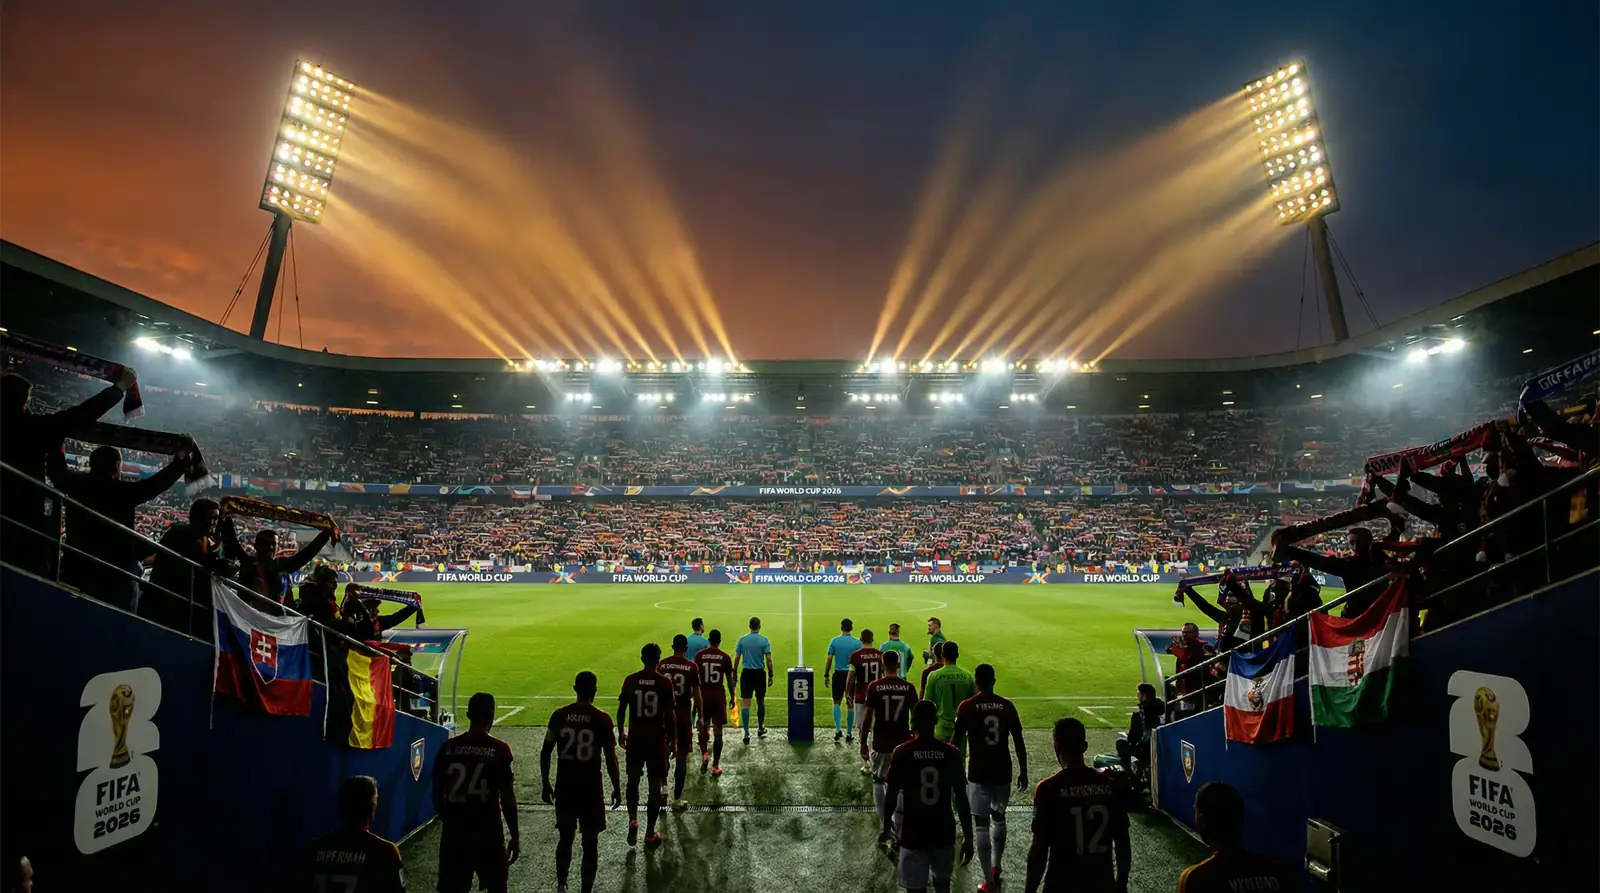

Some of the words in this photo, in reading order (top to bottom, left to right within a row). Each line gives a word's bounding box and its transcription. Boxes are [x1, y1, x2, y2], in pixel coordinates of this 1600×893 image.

[759, 487, 776, 495] FIFA
[777, 487, 805, 495] WORLD
[805, 487, 821, 495] CUP
[822, 487, 842, 495] 2026
[436, 573, 457, 582] FIFA
[458, 573, 493, 582] WORLD
[493, 573, 513, 582] CUP
[612, 574, 633, 583] FIFA
[634, 574, 668, 583] WORLD
[668, 574, 688, 583] CUP
[755, 574, 774, 583] FIFA
[774, 574, 805, 583] WORLD
[805, 574, 823, 583] CUP
[823, 574, 845, 583] 2026
[908, 574, 929, 583] FIFA
[929, 574, 965, 583] WORLD
[965, 574, 985, 583] CUP
[1083, 574, 1104, 583] FIFA
[1104, 574, 1140, 583] WORLD
[1140, 574, 1161, 583] CUP
[702, 661, 722, 684] 15
[862, 661, 880, 683] 19
[634, 689, 659, 719] 19
[881, 694, 906, 722] 17
[559, 726, 595, 762] 28
[983, 714, 1000, 747] 3
[96, 773, 140, 806] FIFA
[446, 761, 490, 805] 24
[919, 765, 941, 806] 8
[1469, 774, 1514, 809] FIFA
[95, 801, 124, 818] WORLD
[126, 796, 141, 807] CUP
[1469, 798, 1498, 815] WORLD
[1499, 809, 1516, 820] CUP
[93, 808, 140, 839] 2026
[1070, 804, 1110, 856] 12
[1469, 810, 1517, 840] 2026
